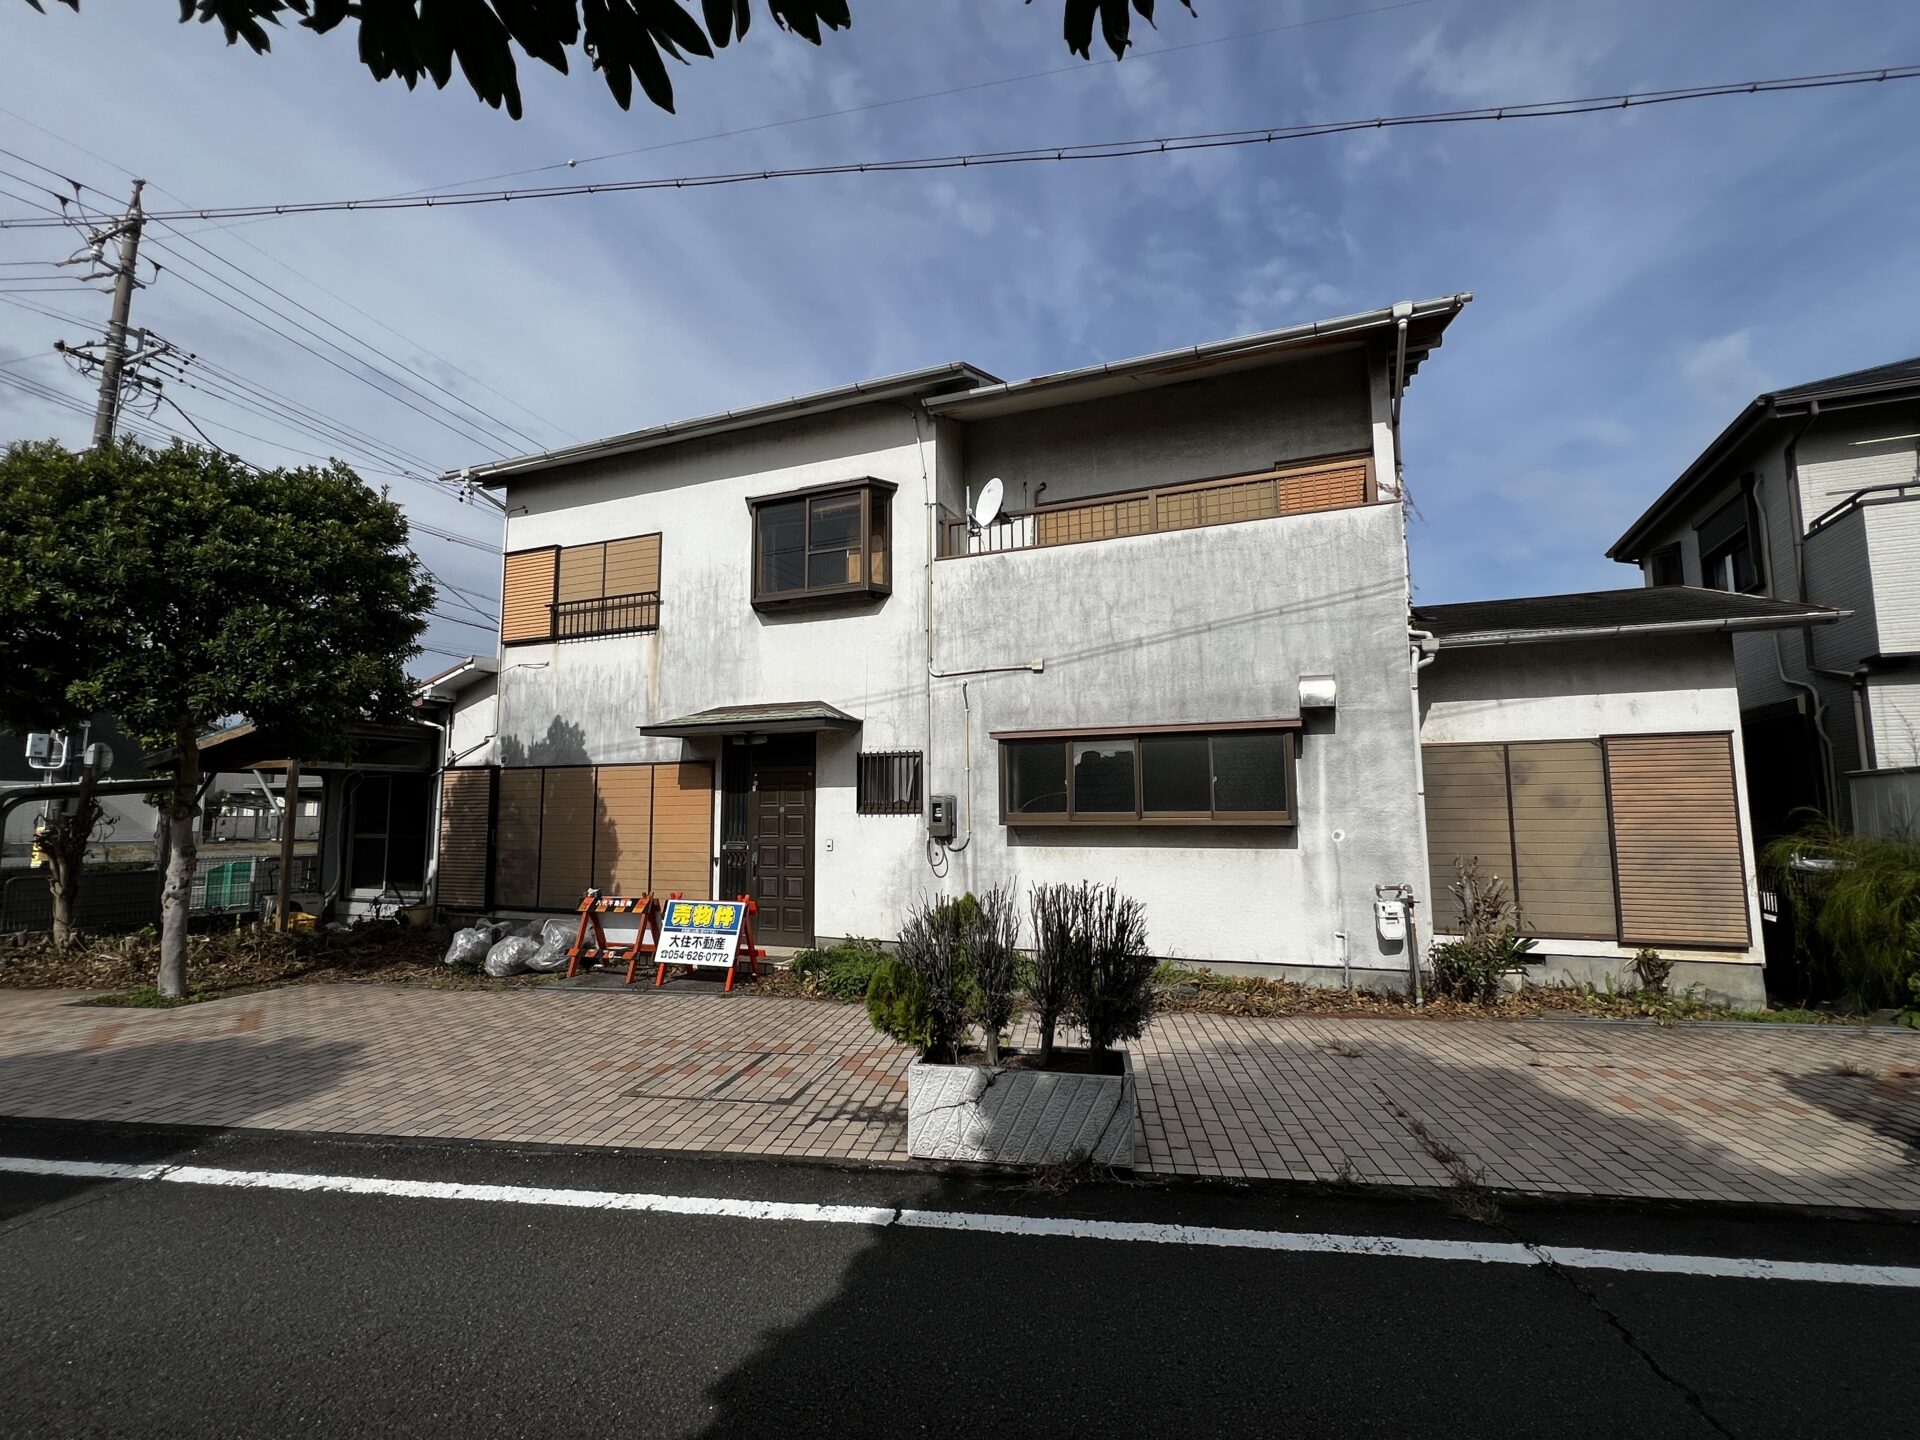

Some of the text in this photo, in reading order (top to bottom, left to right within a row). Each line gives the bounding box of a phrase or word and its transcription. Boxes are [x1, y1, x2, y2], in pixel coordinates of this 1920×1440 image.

[672, 904, 735, 928] 売物件
[669, 935, 726, 950] 大住不動産
